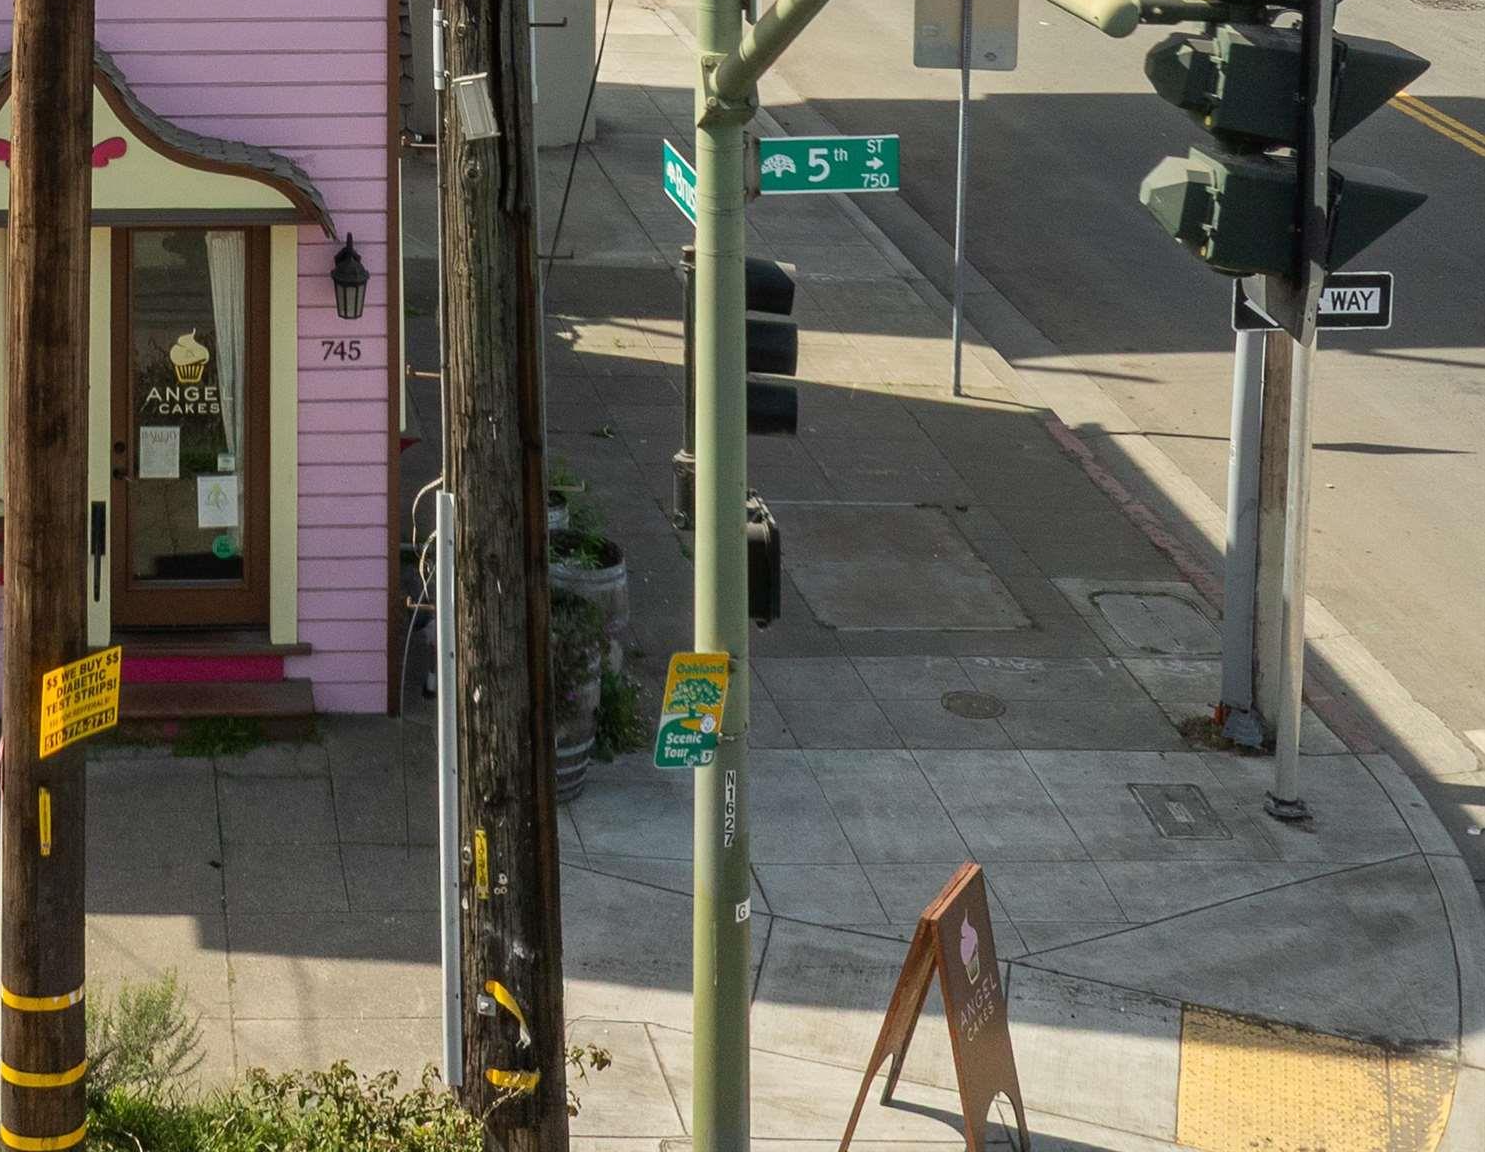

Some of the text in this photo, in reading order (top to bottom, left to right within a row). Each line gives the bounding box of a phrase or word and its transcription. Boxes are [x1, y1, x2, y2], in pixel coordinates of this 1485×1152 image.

[808, 139, 884, 182] 5th ST
[860, 173, 890, 188] 750
[1331, 290, 1374, 311] WAY
[321, 340, 361, 362] 745
[146, 386, 233, 402] ANGEL
[159, 403, 221, 415] CAKES
[61, 667, 77, 683] WE
[80, 656, 102, 676] BUY
[676, 663, 725, 674] Oakland
[57, 668, 106, 699] DIABETIC
[46, 694, 71, 717] TEST
[74, 677, 117, 704] STRIPS!
[666, 731, 703, 744] Scenic
[664, 746, 689, 759] Tour
[725, 771, 735, 846] N1627
[961, 972, 997, 1032] ANGEL
[967, 1001, 996, 1042] CAKES
